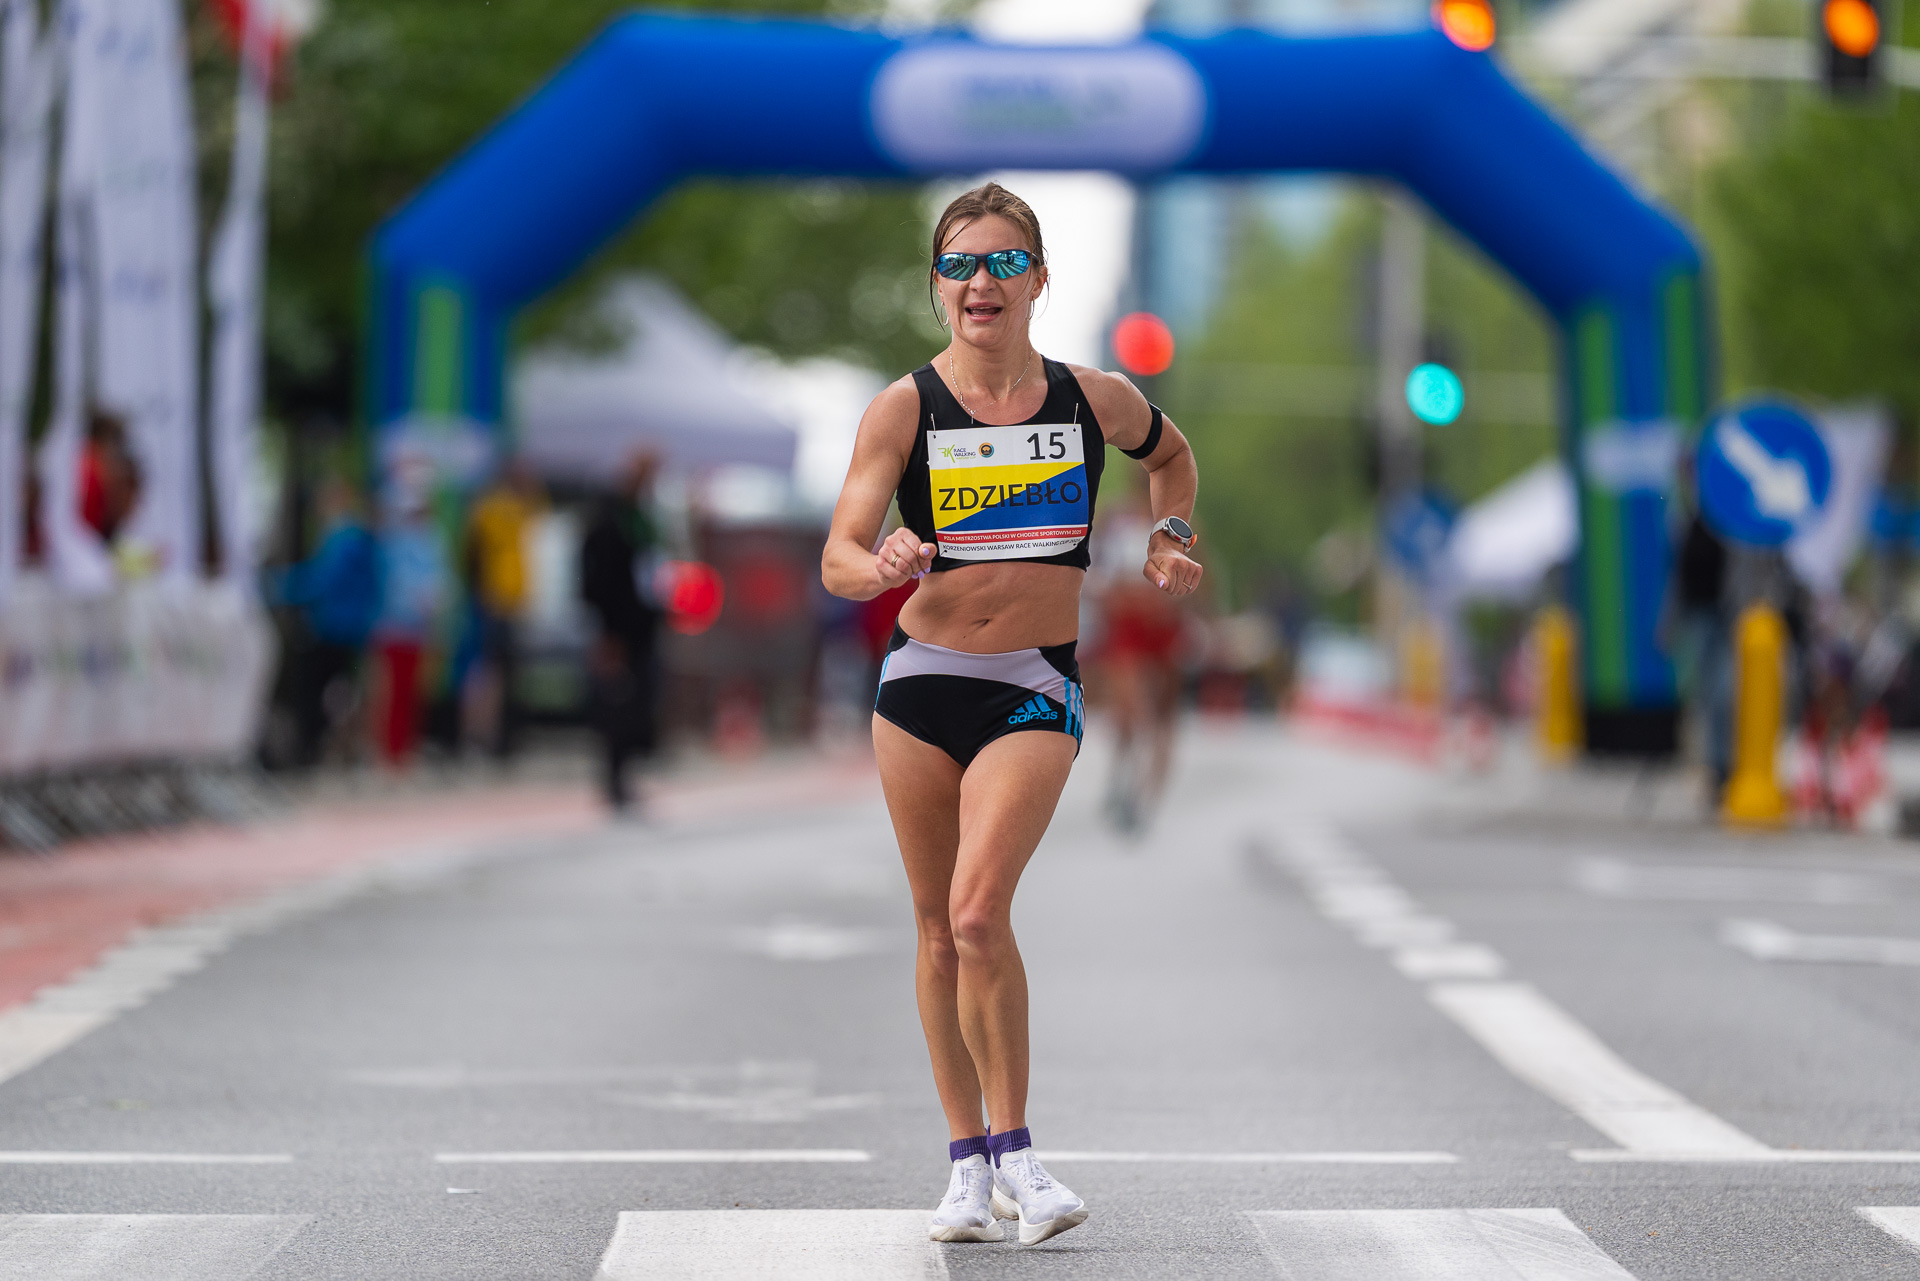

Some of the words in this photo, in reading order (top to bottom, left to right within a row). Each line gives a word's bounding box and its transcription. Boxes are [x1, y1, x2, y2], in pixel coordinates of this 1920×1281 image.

[1026, 432, 1066, 461] 15
[938, 481, 1082, 511] ZDZIEBŁO
[992, 532, 1010, 540] POLSKI
[942, 544, 986, 552] KORZENIOWSKI
[987, 543, 1015, 551] WARSAW
[1008, 711, 1058, 724] adidas
